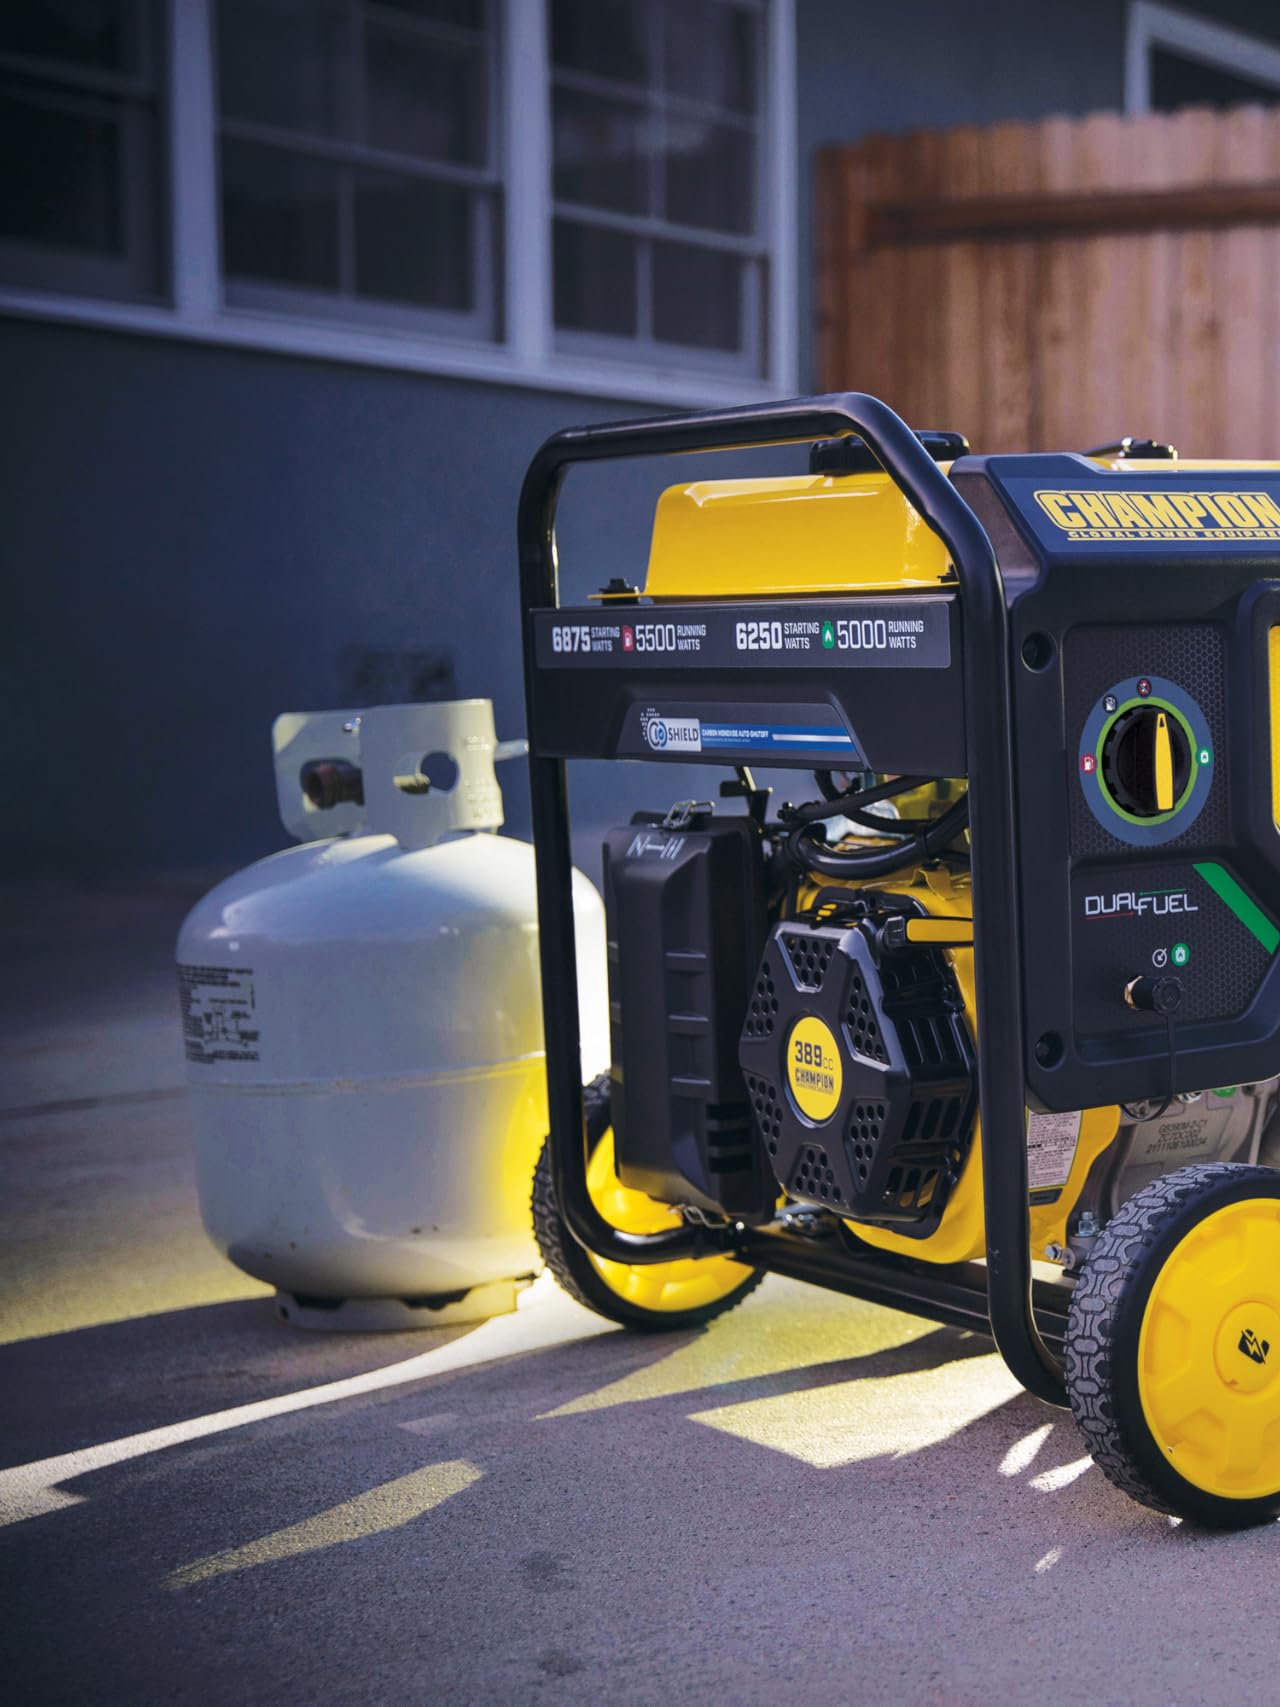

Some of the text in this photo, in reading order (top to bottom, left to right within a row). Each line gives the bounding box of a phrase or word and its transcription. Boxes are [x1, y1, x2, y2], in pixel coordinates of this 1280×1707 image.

[1068, 530, 1136, 538] GLOBAL
[1137, 530, 1197, 538] POWER
[591, 626, 620, 638] STARTING
[677, 625, 707, 636] RUNNING
[784, 622, 820, 635] STARTING
[888, 620, 924, 633] RUNNING
[552, 626, 591, 652] 6875
[635, 624, 676, 651] 5500
[736, 622, 782, 650] 6250
[837, 620, 887, 649] 5000
[592, 640, 613, 651] WATTS
[678, 639, 700, 650] WATTS
[785, 637, 810, 649] WATTS
[889, 636, 917, 649] WATTS
[668, 727, 699, 742] SHIELD
[795, 1068, 834, 1089] CHAMPION
